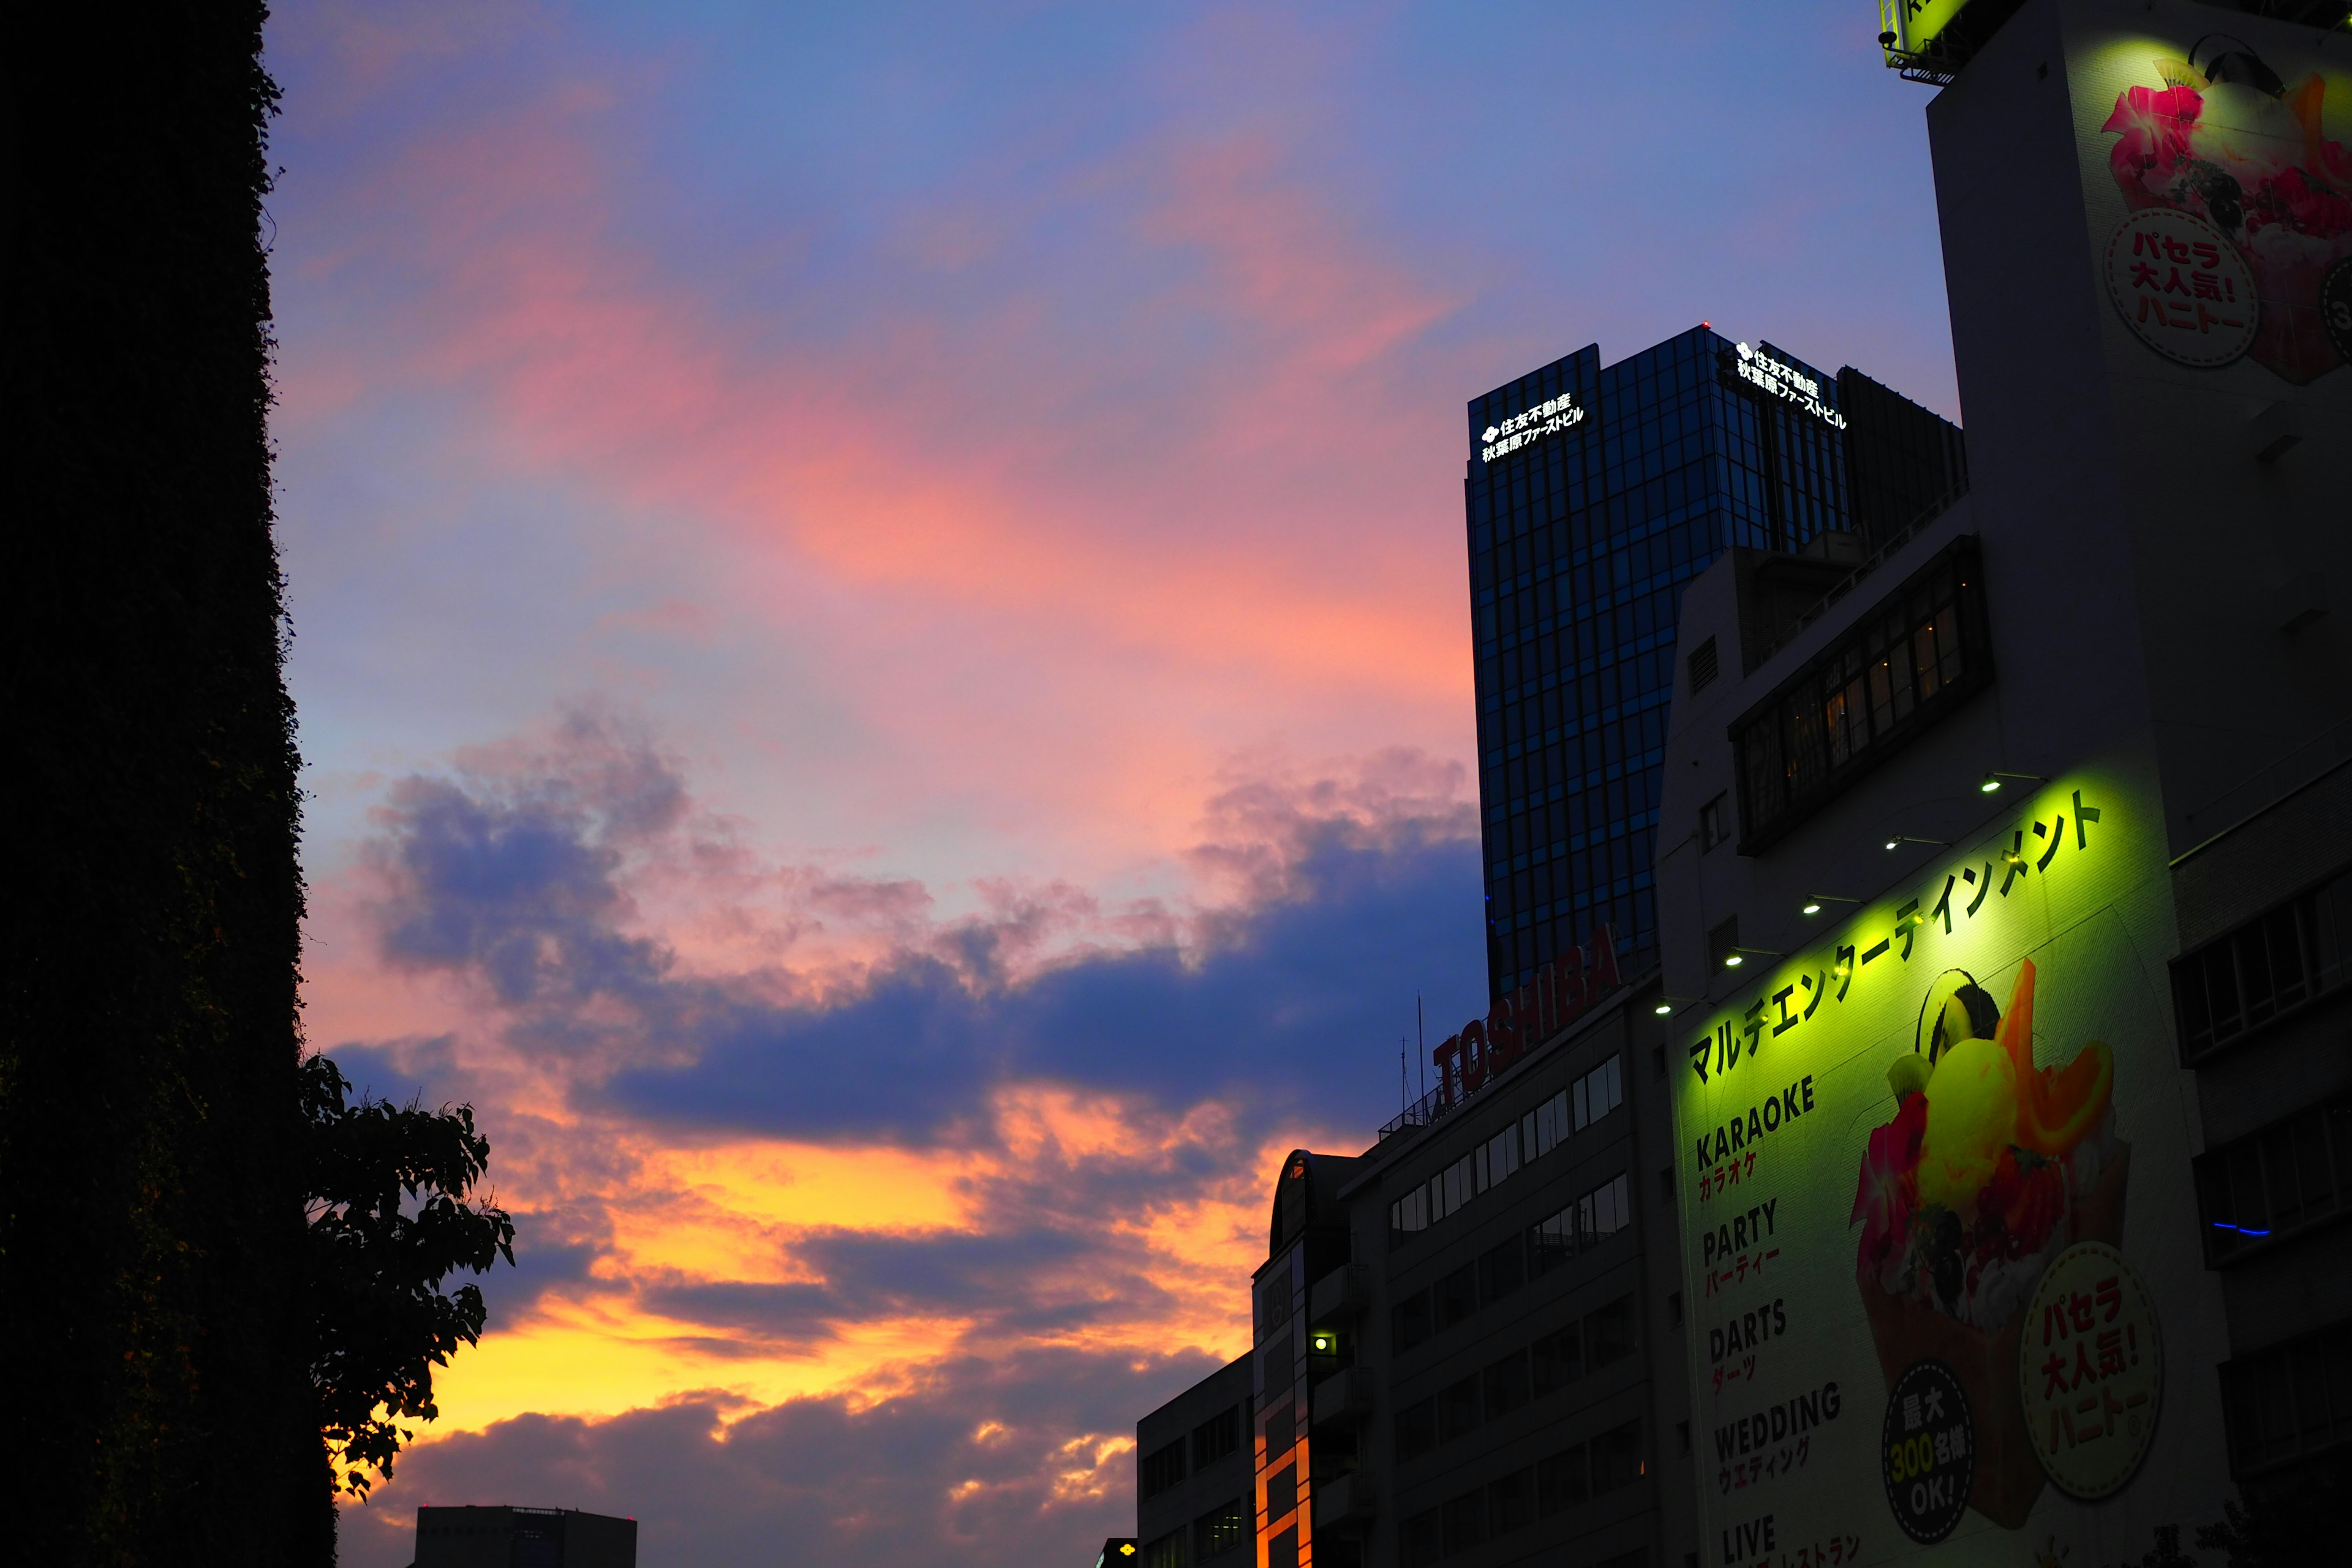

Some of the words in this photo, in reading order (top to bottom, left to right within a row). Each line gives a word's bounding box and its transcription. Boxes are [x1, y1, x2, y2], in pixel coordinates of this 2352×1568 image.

[2133, 232, 2220, 269] パセラ
[2130, 262, 2235, 303] 大人気!
[2138, 295, 2244, 334] ハニトー
[1737, 359, 1847, 429] 秋葉原ファーストビル
[1754, 350, 1819, 399] 住友不動産
[1482, 407, 1584, 462] 秋葉原ファーストビル
[1500, 393, 1572, 437] 住友不動産
[1433, 922, 1621, 1106] TOSHIBA
[1697, 1075, 1814, 1172] KARAOKE
[1699, 1152, 1756, 1202] カラオケ
[1703, 1198, 1777, 1267] PARTY
[1705, 1248, 1779, 1297] パーティー
[1710, 1298, 1786, 1363] DARTS
[2043, 1275, 2122, 1346] パセラ
[1712, 1354, 1755, 1395] ダーツ
[2041, 1323, 2138, 1400] 大人気!
[1714, 1382, 1841, 1462] WEDDING
[1902, 1386, 1945, 1431] 最大
[1891, 1425, 1966, 1483] 300名様
[1910, 1474, 1954, 1515] OK!
[1723, 1515, 1775, 1565] LIVE
